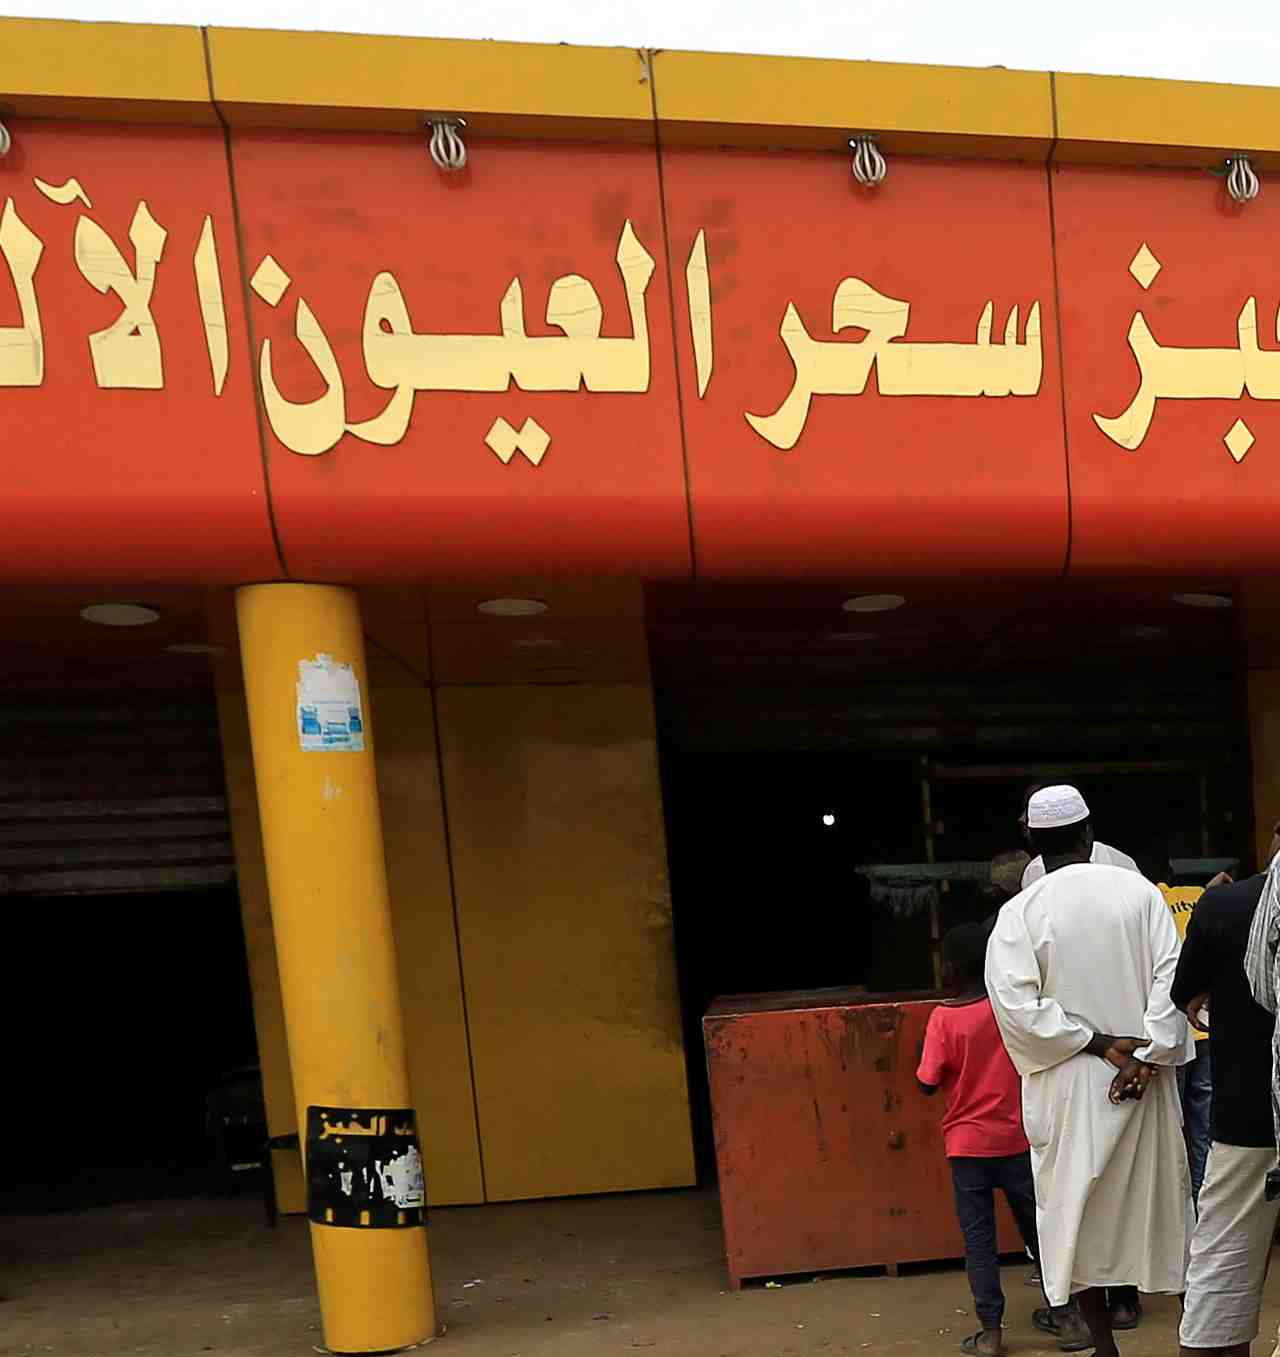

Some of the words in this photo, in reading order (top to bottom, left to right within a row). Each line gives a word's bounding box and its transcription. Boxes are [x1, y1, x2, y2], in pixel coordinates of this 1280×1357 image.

[0, 176, 230, 398] الآل
[250, 217, 715, 467] العيون
[744, 276, 1044, 451] سحر
[1171, 900, 1197, 914] lity
[319, 1112, 387, 1143] الخبز
